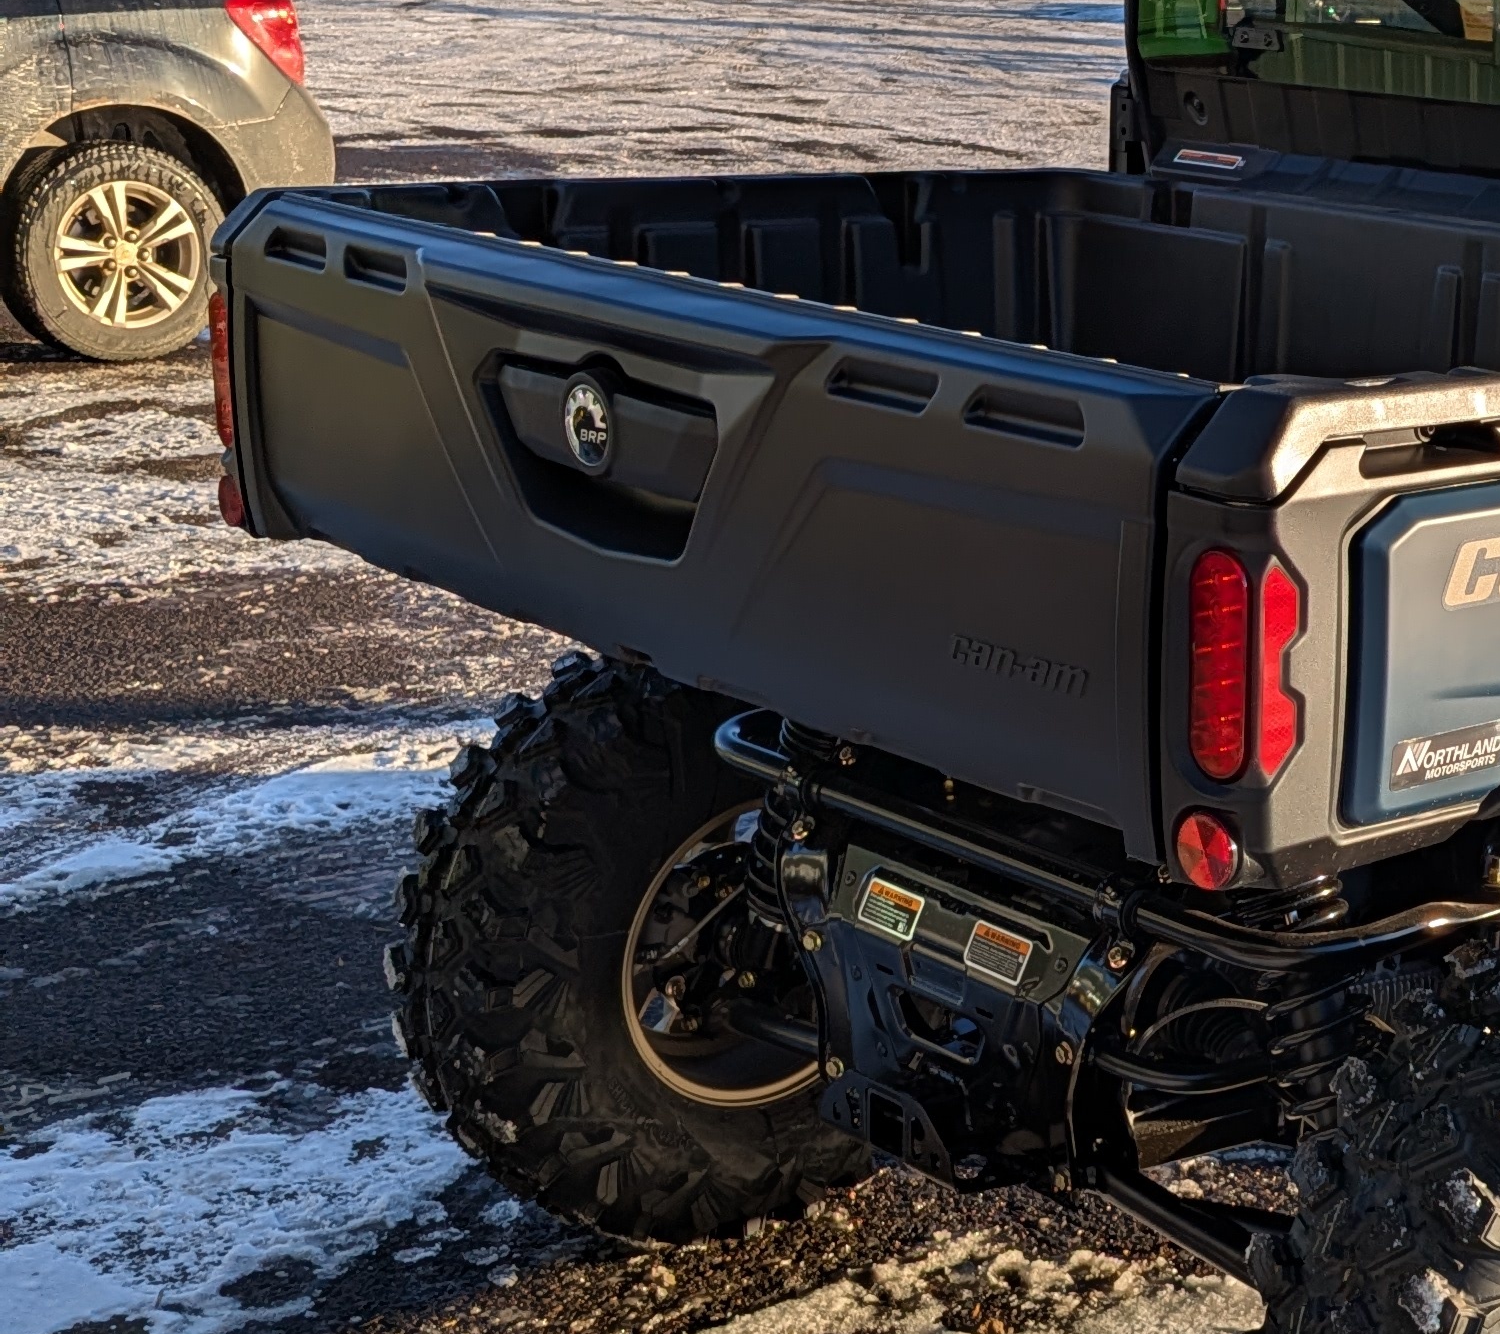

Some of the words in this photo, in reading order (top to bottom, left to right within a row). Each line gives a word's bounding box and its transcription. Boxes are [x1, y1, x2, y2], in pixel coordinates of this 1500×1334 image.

[580, 428, 607, 444] BRP
[951, 634, 1090, 699] can-am
[1424, 753, 1497, 781] MOTORSPORTS
